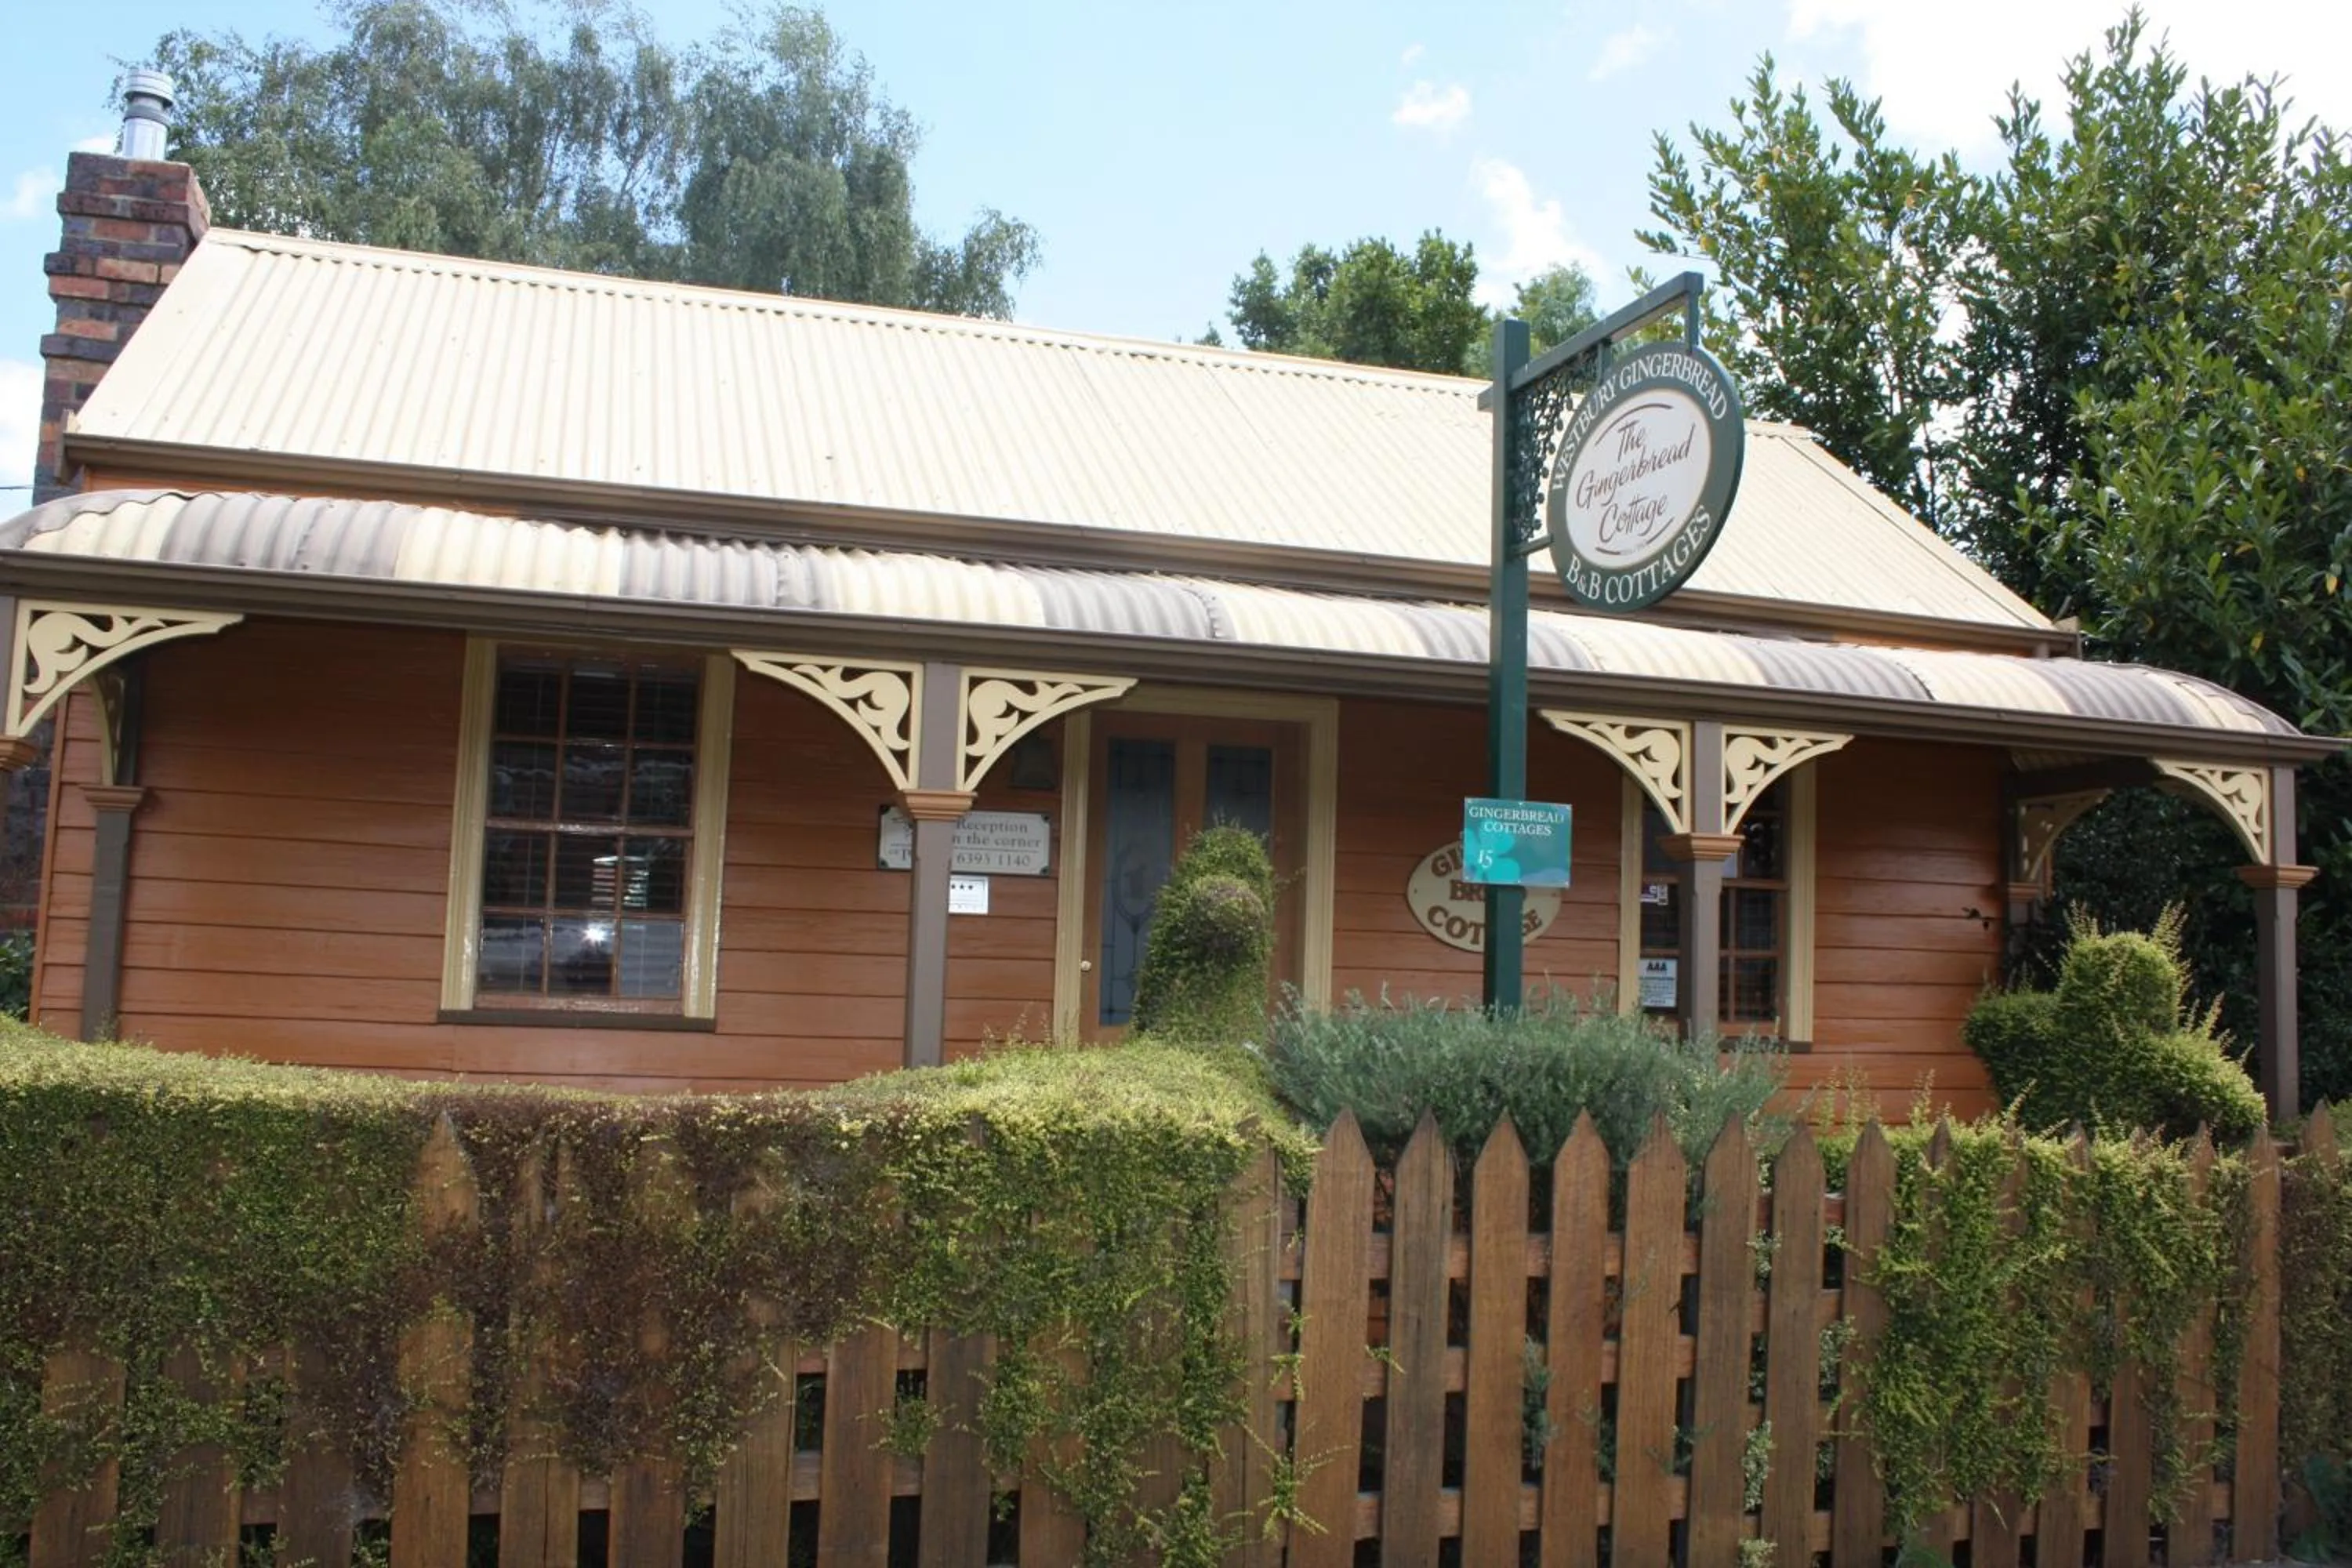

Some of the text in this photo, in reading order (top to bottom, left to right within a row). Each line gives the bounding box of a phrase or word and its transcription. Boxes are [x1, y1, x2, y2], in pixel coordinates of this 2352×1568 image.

[1552, 353, 1727, 490] WESTBURY GINGERBREAD
[1617, 419, 1646, 463] The
[1577, 422, 1696, 510] Gingerbread
[1599, 493, 1668, 544] Cottage
[1566, 505, 1711, 604] B&B COTTAGES
[1468, 806, 1565, 824] GINGERBREAD
[956, 818, 1029, 833] Reception
[1483, 821, 1552, 837] COTTAGES
[966, 831, 990, 845] the
[993, 837, 1042, 848] corner
[998, 853, 1031, 867] 1140
[1478, 849, 1494, 869] 15
